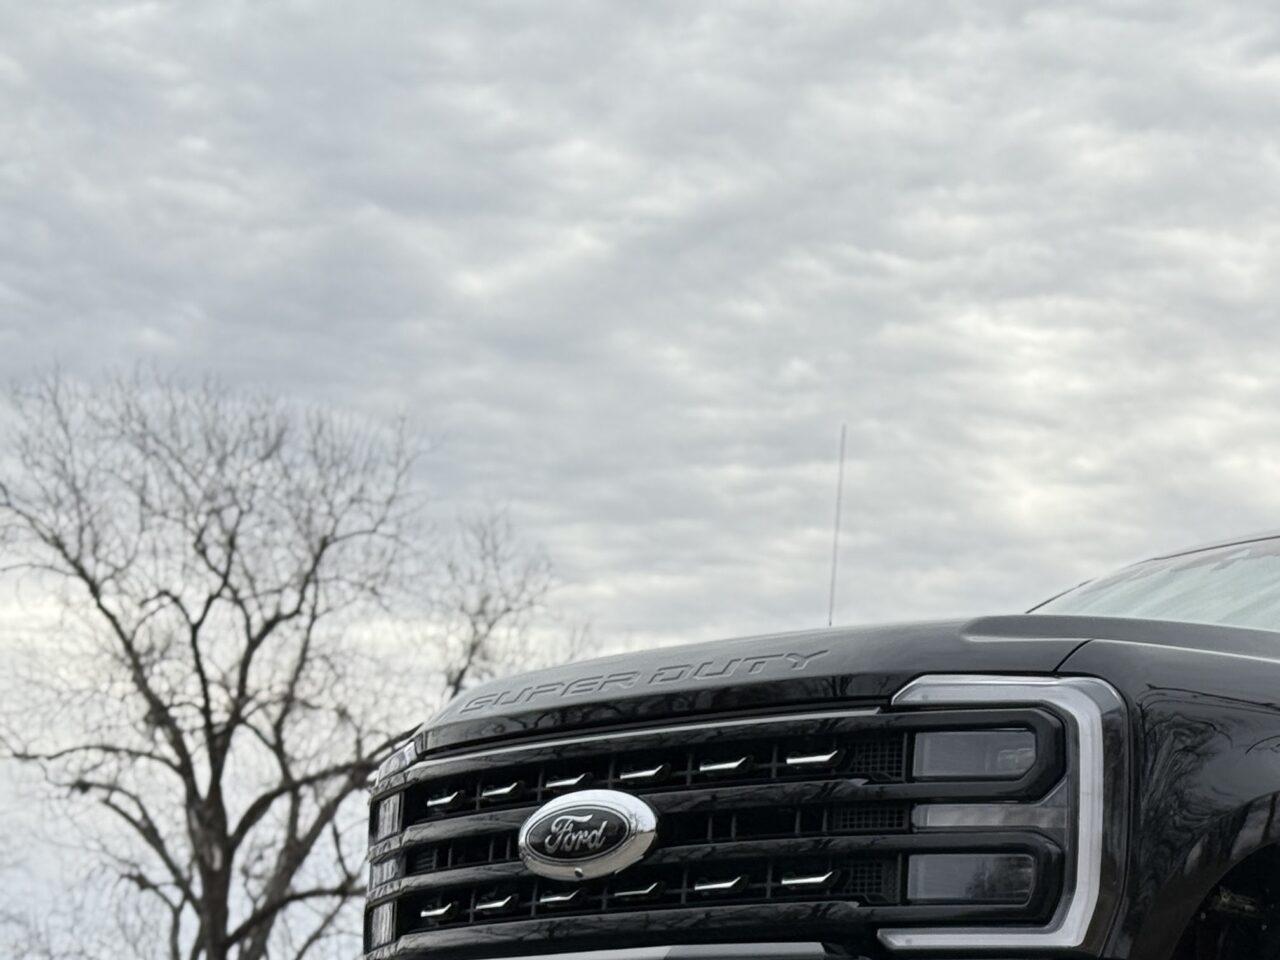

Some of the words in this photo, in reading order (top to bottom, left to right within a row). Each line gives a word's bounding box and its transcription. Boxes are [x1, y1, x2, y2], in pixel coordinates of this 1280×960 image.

[460, 669, 641, 715] SUPER
[647, 649, 830, 687] DUTY
[545, 814, 608, 853] Ford
